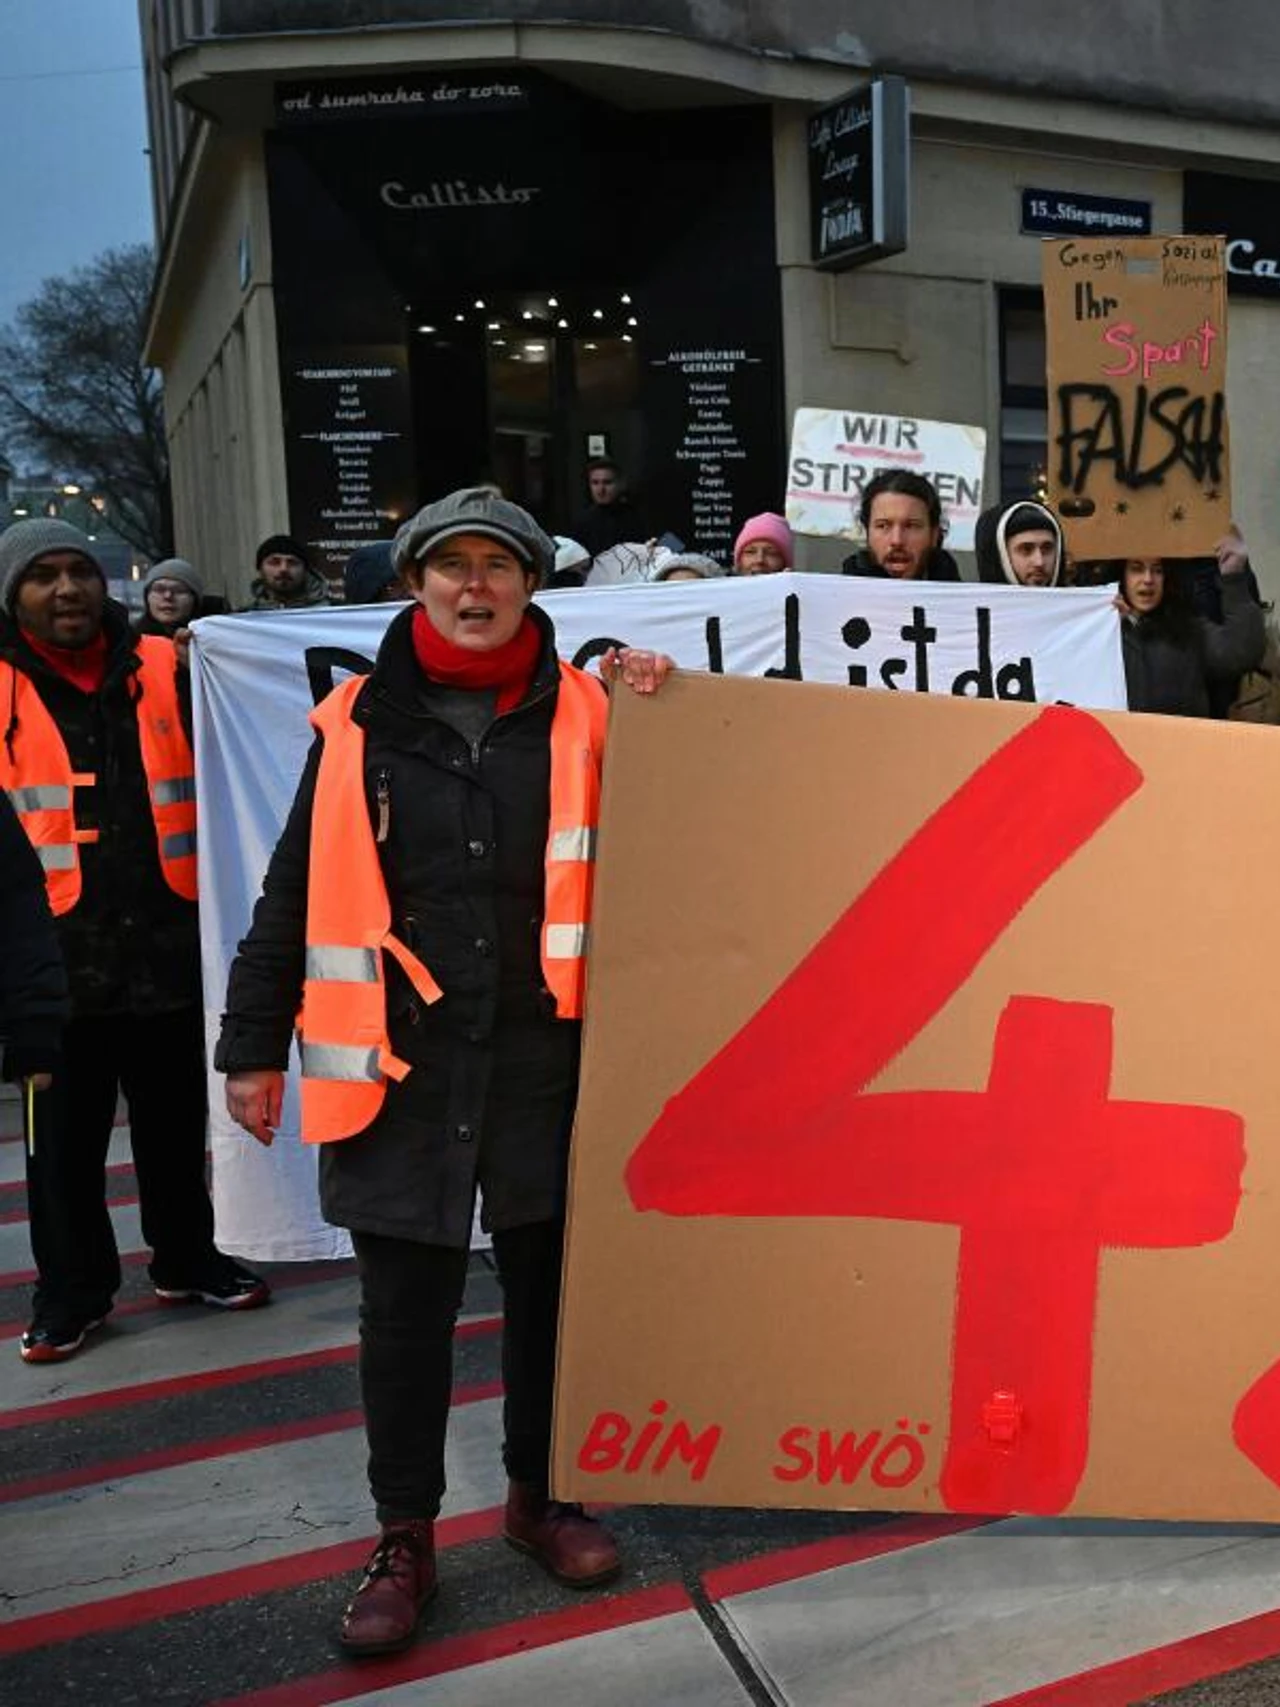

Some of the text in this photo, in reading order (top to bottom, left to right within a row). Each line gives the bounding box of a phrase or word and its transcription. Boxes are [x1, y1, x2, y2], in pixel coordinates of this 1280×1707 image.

[380, 181, 541, 209] Callisto
[1057, 204, 1144, 229] Stiegergasse
[1060, 243, 1124, 270] Gegen
[1075, 282, 1118, 321] Ihr
[1102, 320, 1217, 379] Spart
[843, 416, 919, 449] WIR
[1056, 383, 1225, 493] FALSCH
[792, 458, 981, 507] STREN
[773, 1418, 931, 1488] SWÖ
